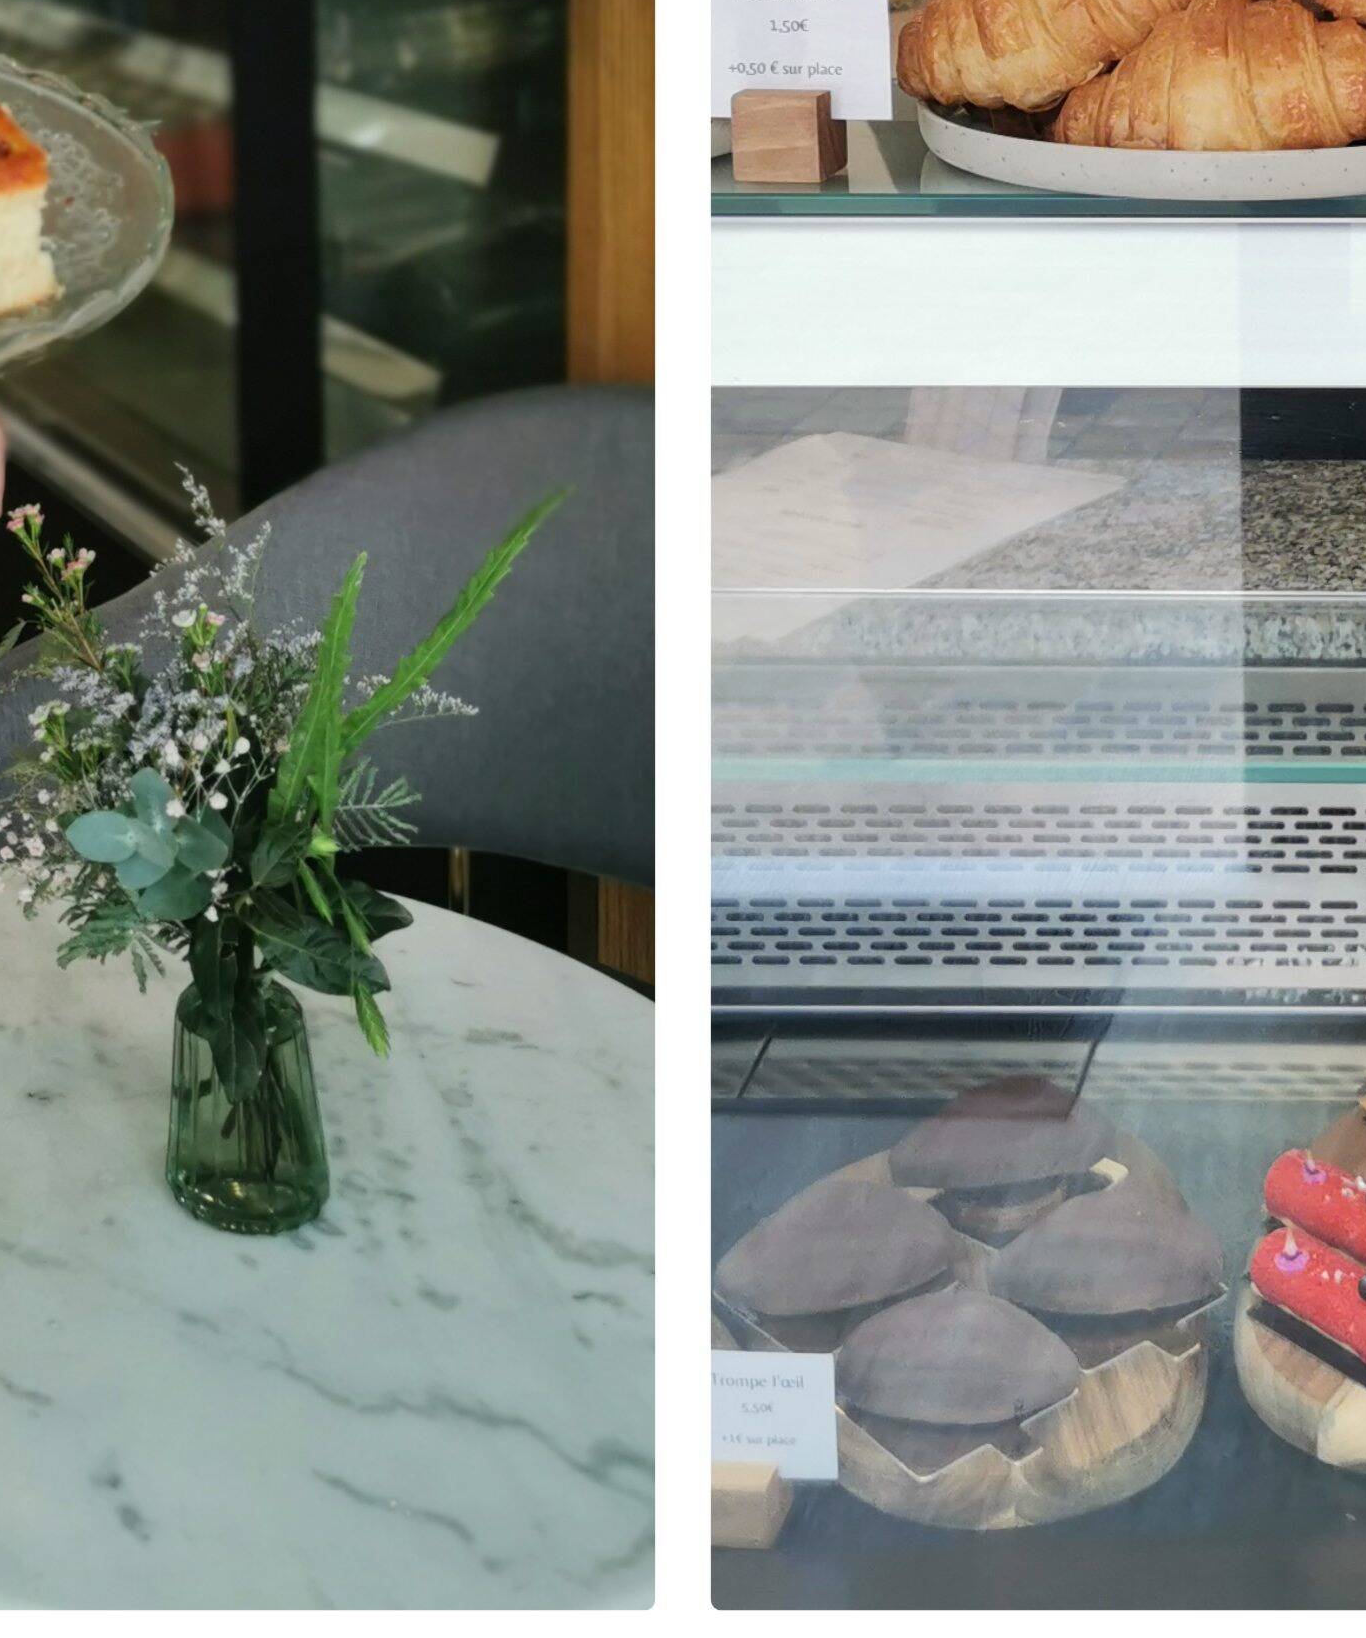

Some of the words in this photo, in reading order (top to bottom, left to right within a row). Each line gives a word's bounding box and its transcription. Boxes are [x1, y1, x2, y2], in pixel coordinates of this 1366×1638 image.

[769, 18, 810, 33] 1,50€
[728, 61, 767, 76] +0,50
[770, 60, 779, 75] €
[782, 64, 803, 75] sur
[807, 61, 843, 78] place
[711, 1372, 768, 1391] Trompe
